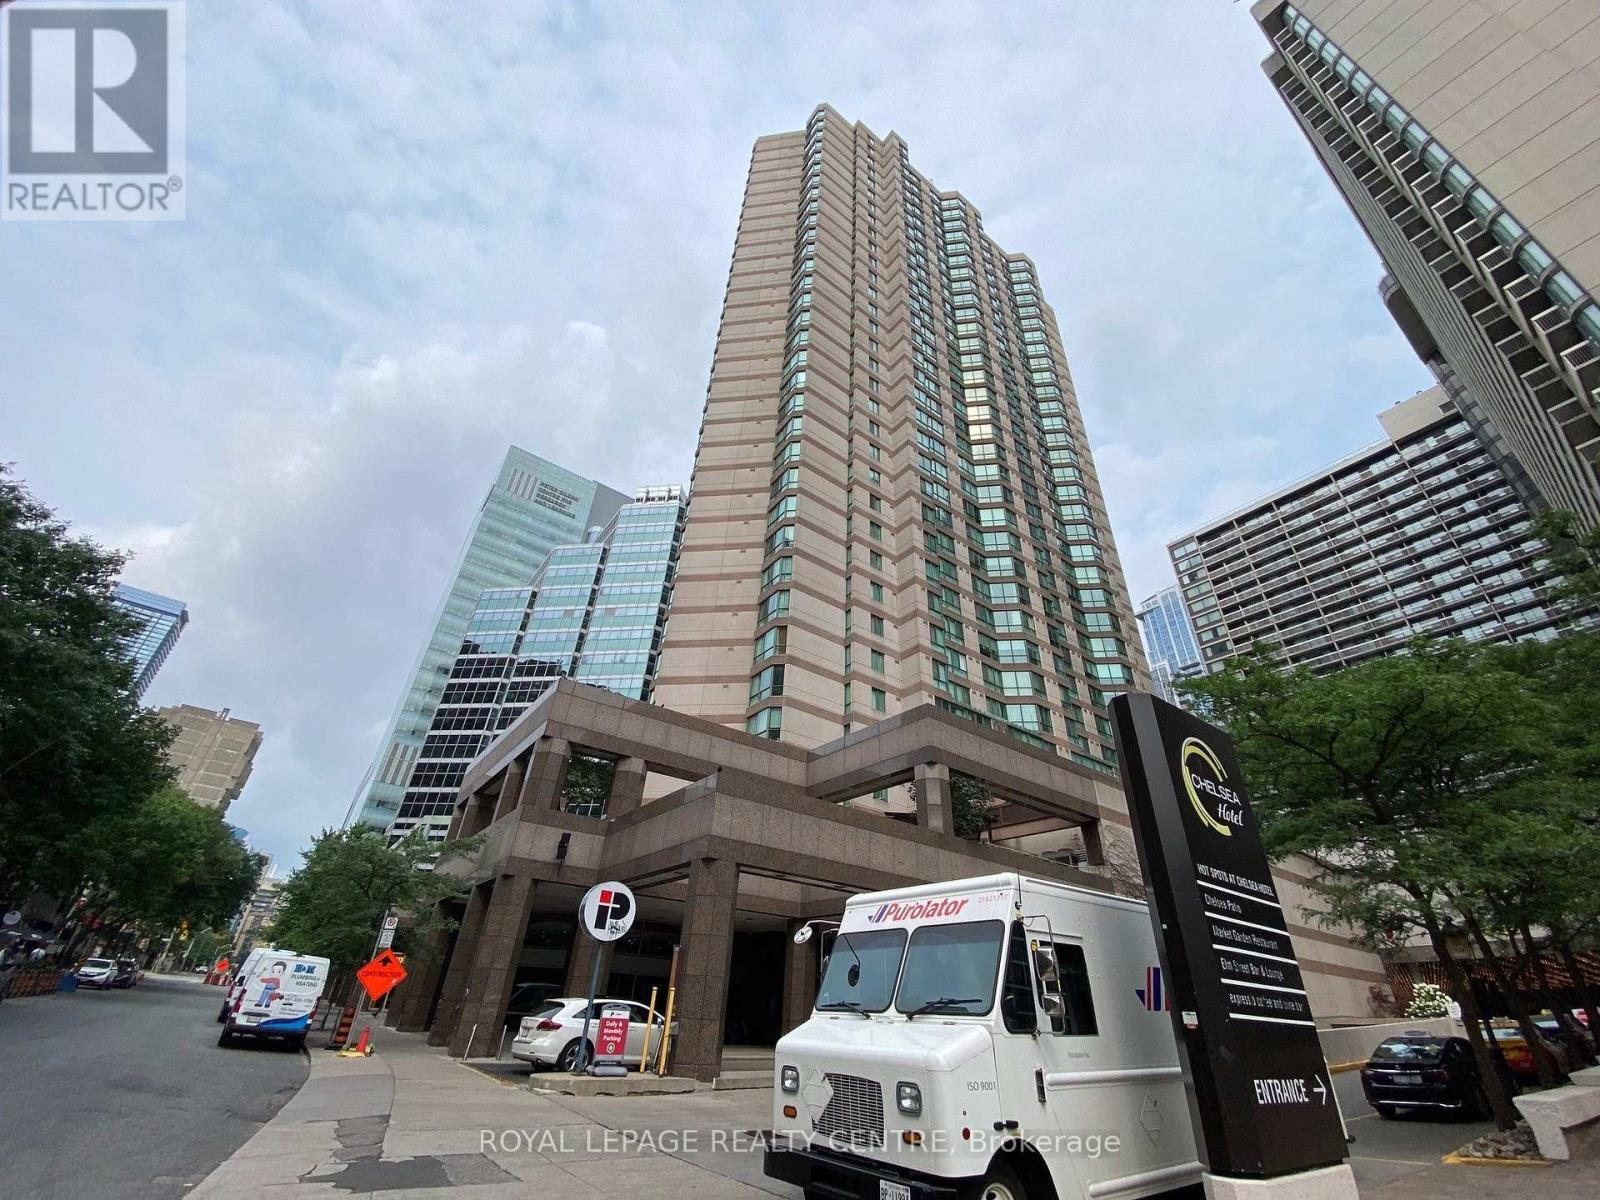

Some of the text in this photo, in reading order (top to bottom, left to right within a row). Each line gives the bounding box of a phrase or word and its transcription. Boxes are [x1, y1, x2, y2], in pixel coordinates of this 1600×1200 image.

[1191, 773, 1242, 806] CHELSEA
[1217, 803, 1244, 826] Hotel
[1196, 863, 1275, 897] HOT SPOTS AT CHELSEA HOTEL
[882, 898, 969, 922] Purolator
[605, 1020, 618, 1028] Daily
[602, 1035, 622, 1043] Parking
[967, 1081, 996, 1091] ISO 9001
[1253, 1078, 1309, 1105] ENTRANCE
